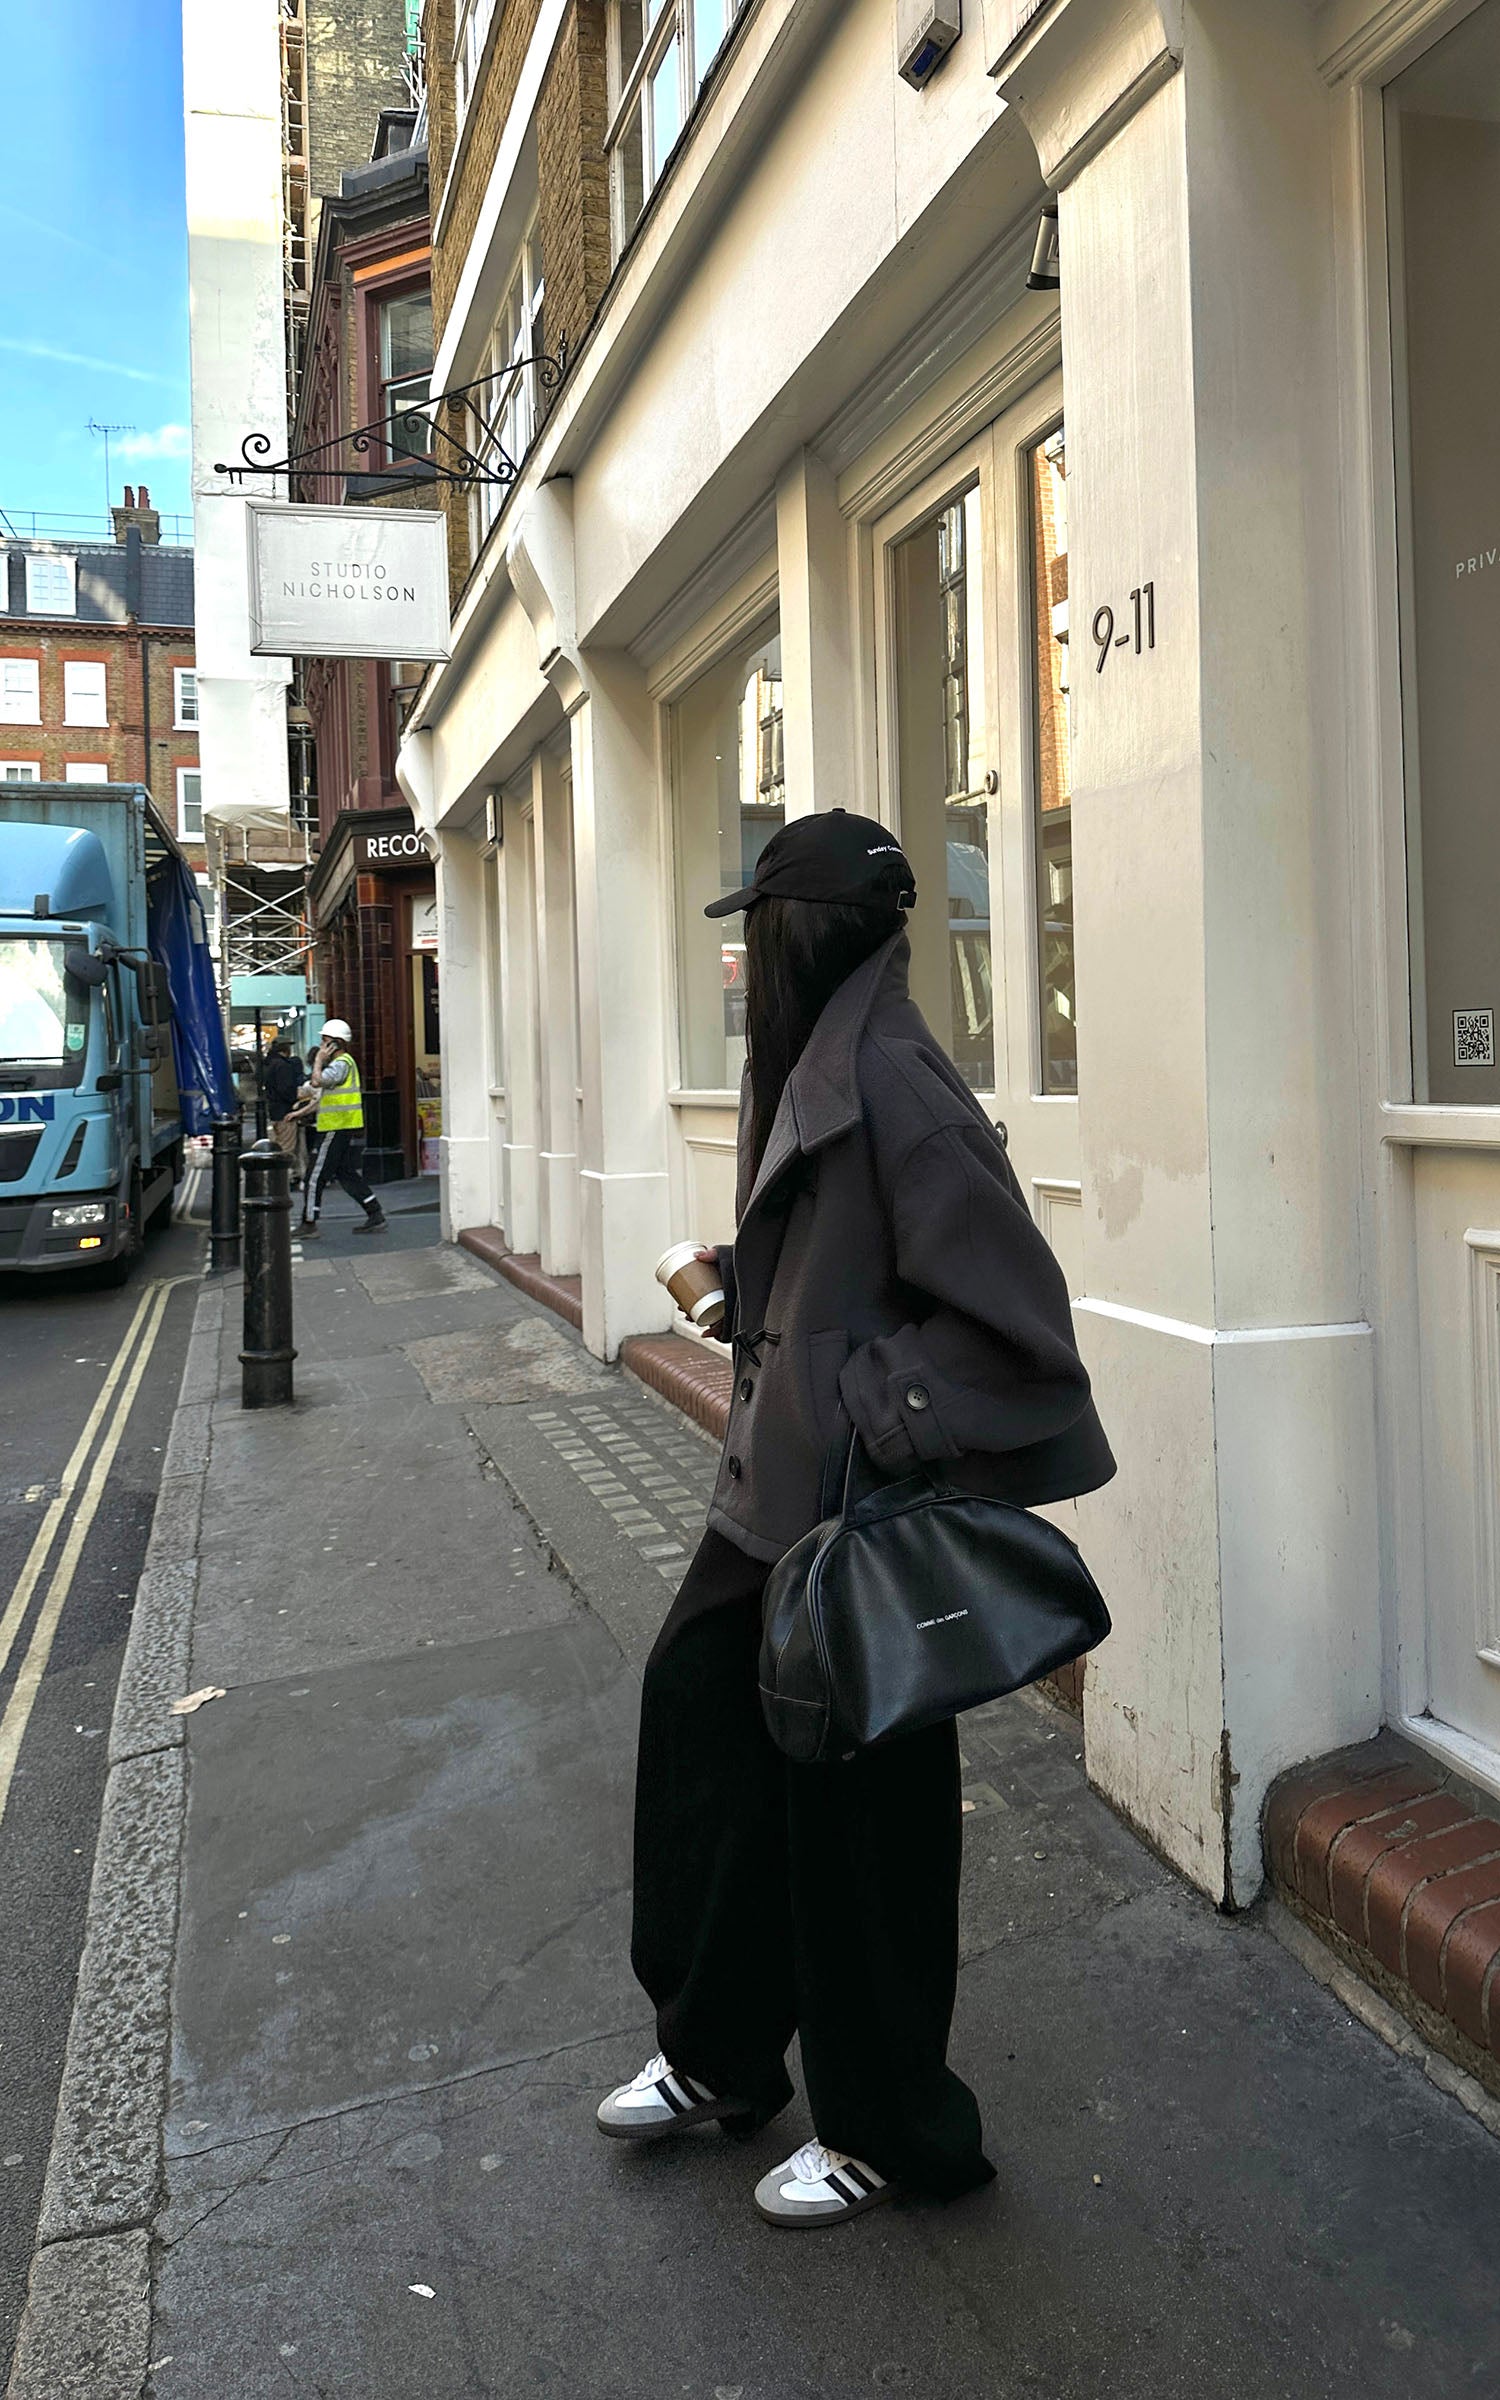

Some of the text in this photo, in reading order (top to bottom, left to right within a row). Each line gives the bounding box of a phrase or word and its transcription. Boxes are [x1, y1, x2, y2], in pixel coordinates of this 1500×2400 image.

[311, 561, 386, 579] STUDIO
[1456, 548, 1500, 579] PRIV
[283, 582, 415, 601] NICHOLSON
[1092, 581, 1155, 674] 9-11
